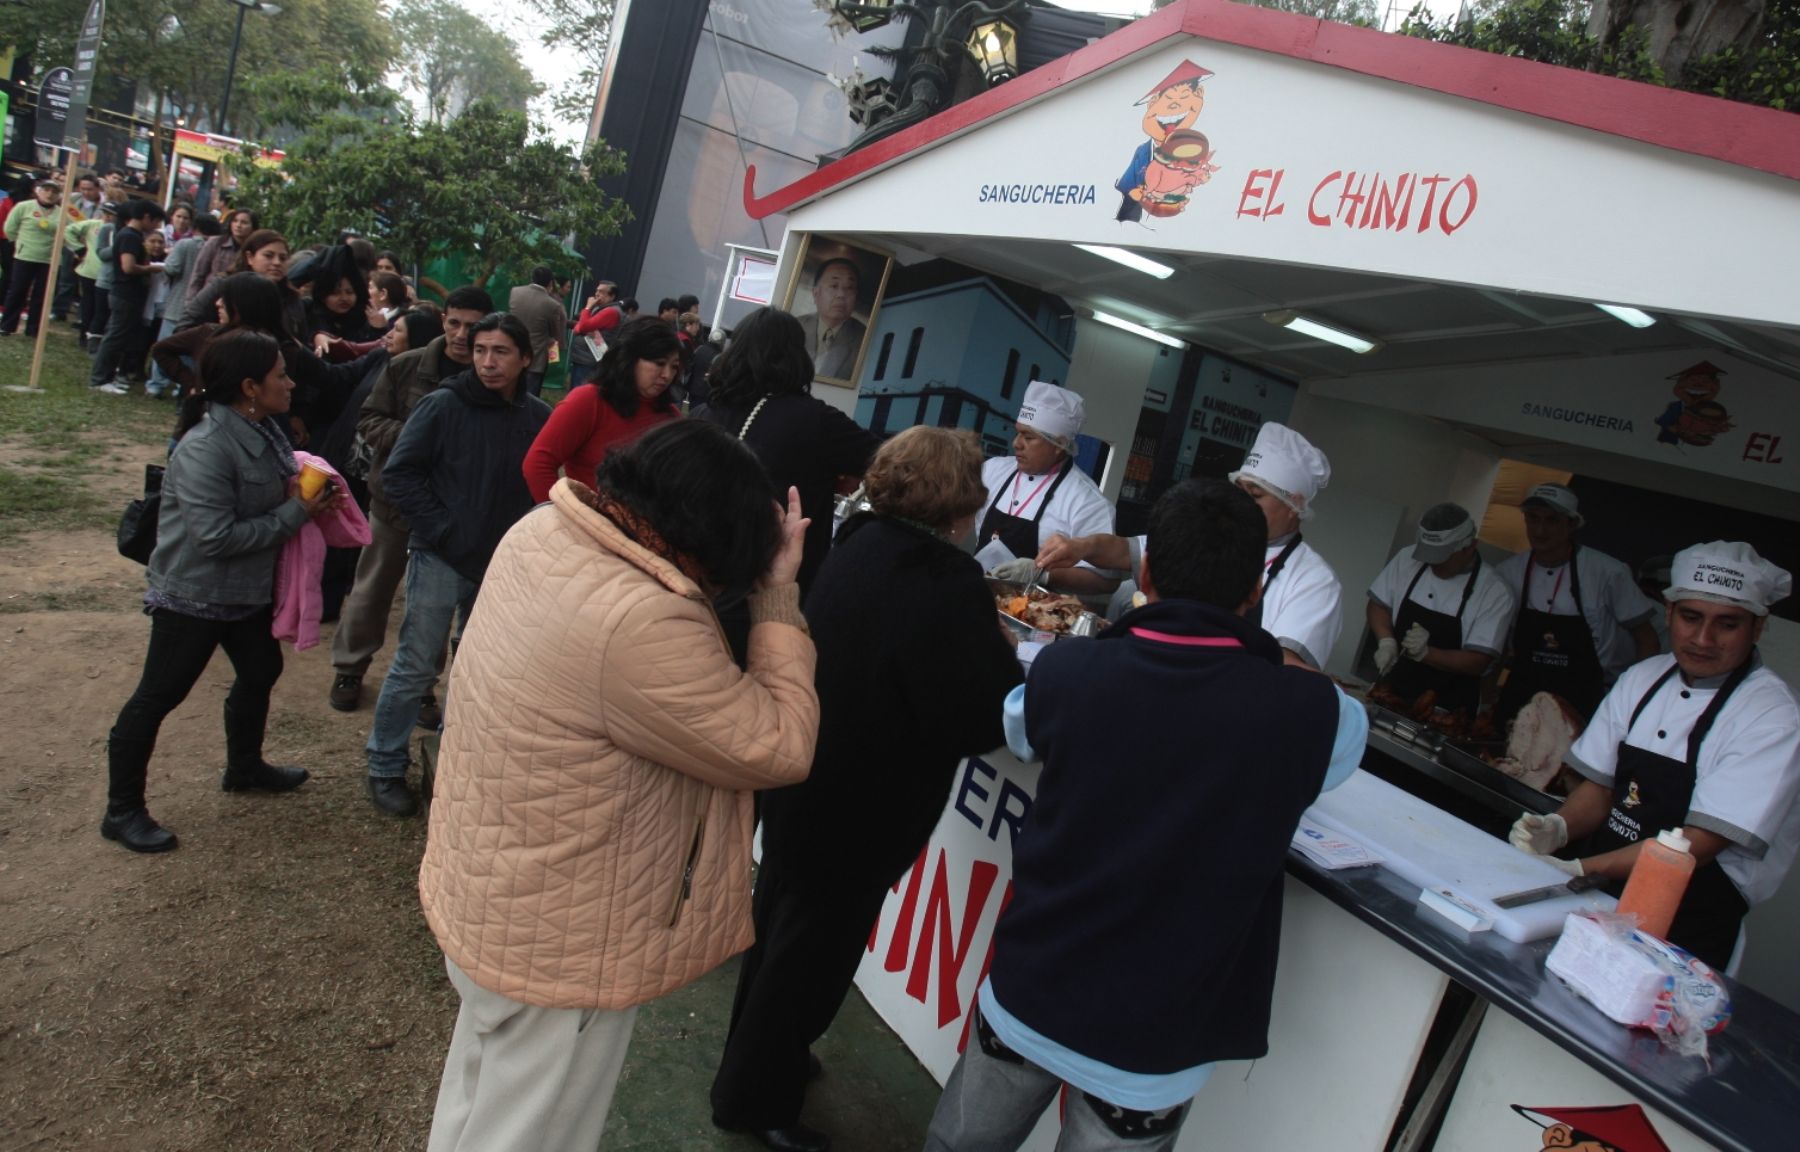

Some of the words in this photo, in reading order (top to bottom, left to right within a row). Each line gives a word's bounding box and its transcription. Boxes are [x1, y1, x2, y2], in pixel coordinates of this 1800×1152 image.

[978, 184, 1096, 205] SANGUCHERIA
[1236, 168, 1286, 222] EL
[1307, 169, 1479, 236] CHINITO
[1190, 409, 1208, 433] EL
[1211, 416, 1257, 446] CHINIT
[1521, 402, 1634, 433] SANGUCHERIA
[1742, 432, 1783, 464] EL
[1693, 571, 1704, 583] EL
